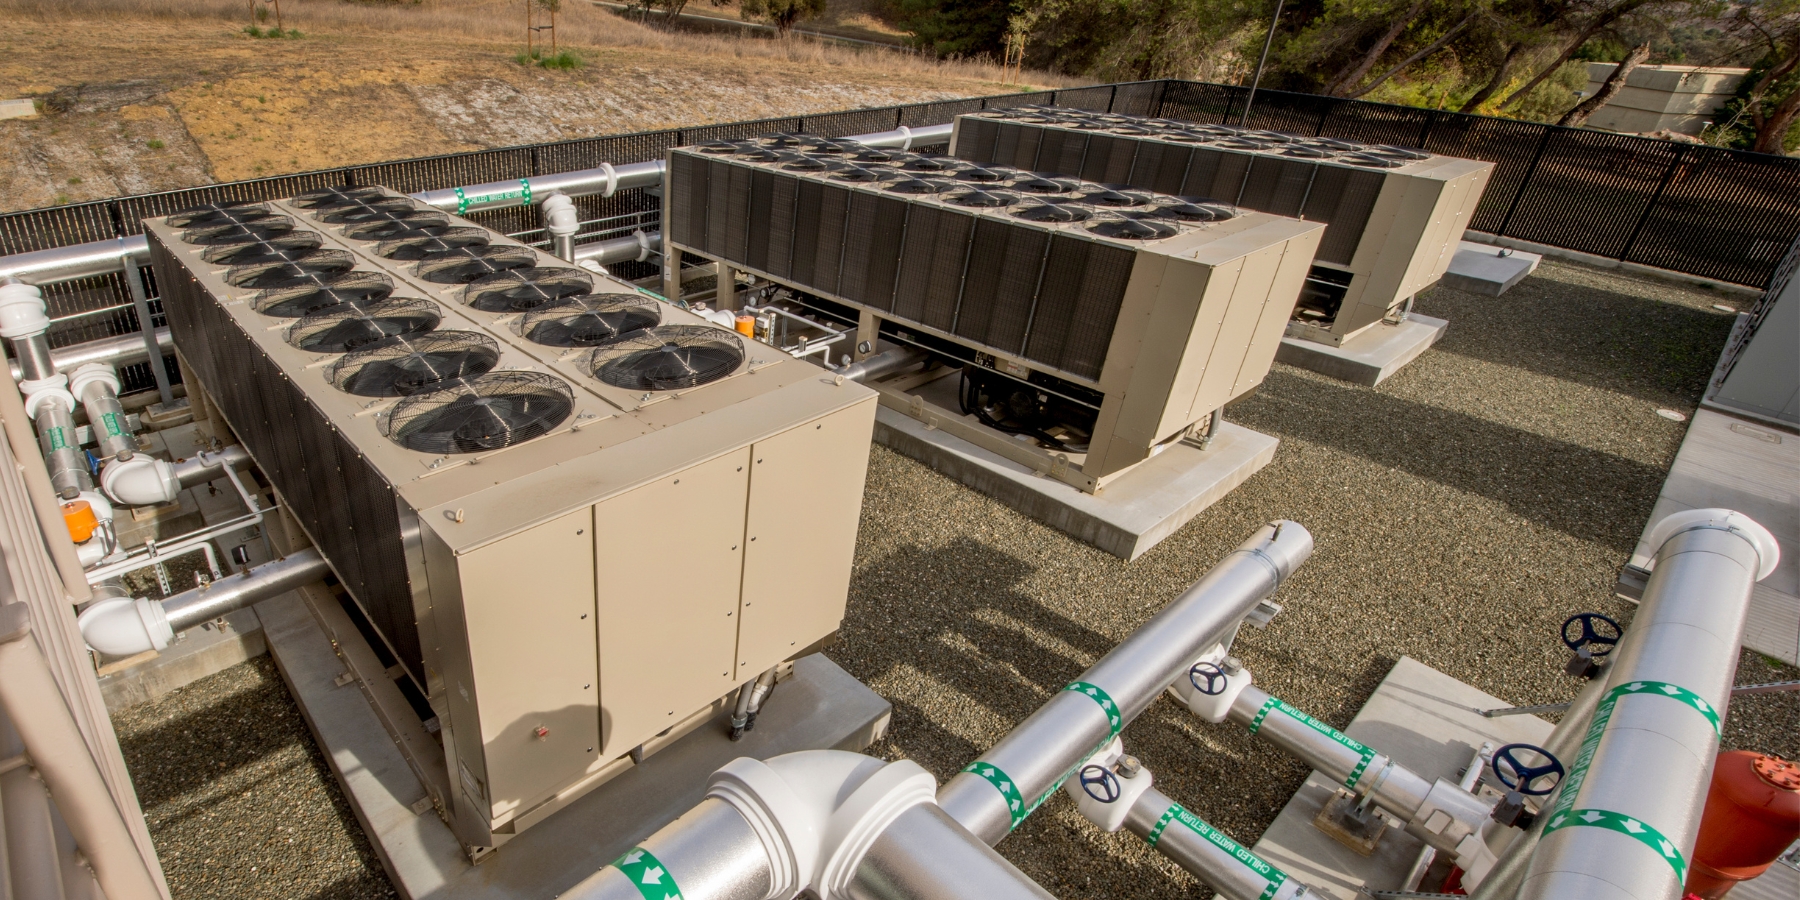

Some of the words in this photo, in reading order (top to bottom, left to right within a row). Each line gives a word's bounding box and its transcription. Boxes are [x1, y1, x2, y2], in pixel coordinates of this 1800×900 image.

[489, 193, 504, 202] WATER
[505, 190, 522, 199] RETURN
[1279, 703, 1308, 721] RETURN
[1308, 717, 1332, 734] WATER
[1333, 732, 1363, 751] CHILLED
[1178, 810, 1210, 834] RETURN
[1209, 831, 1236, 852] WATER
[1236, 848, 1271, 874] CHILLED
